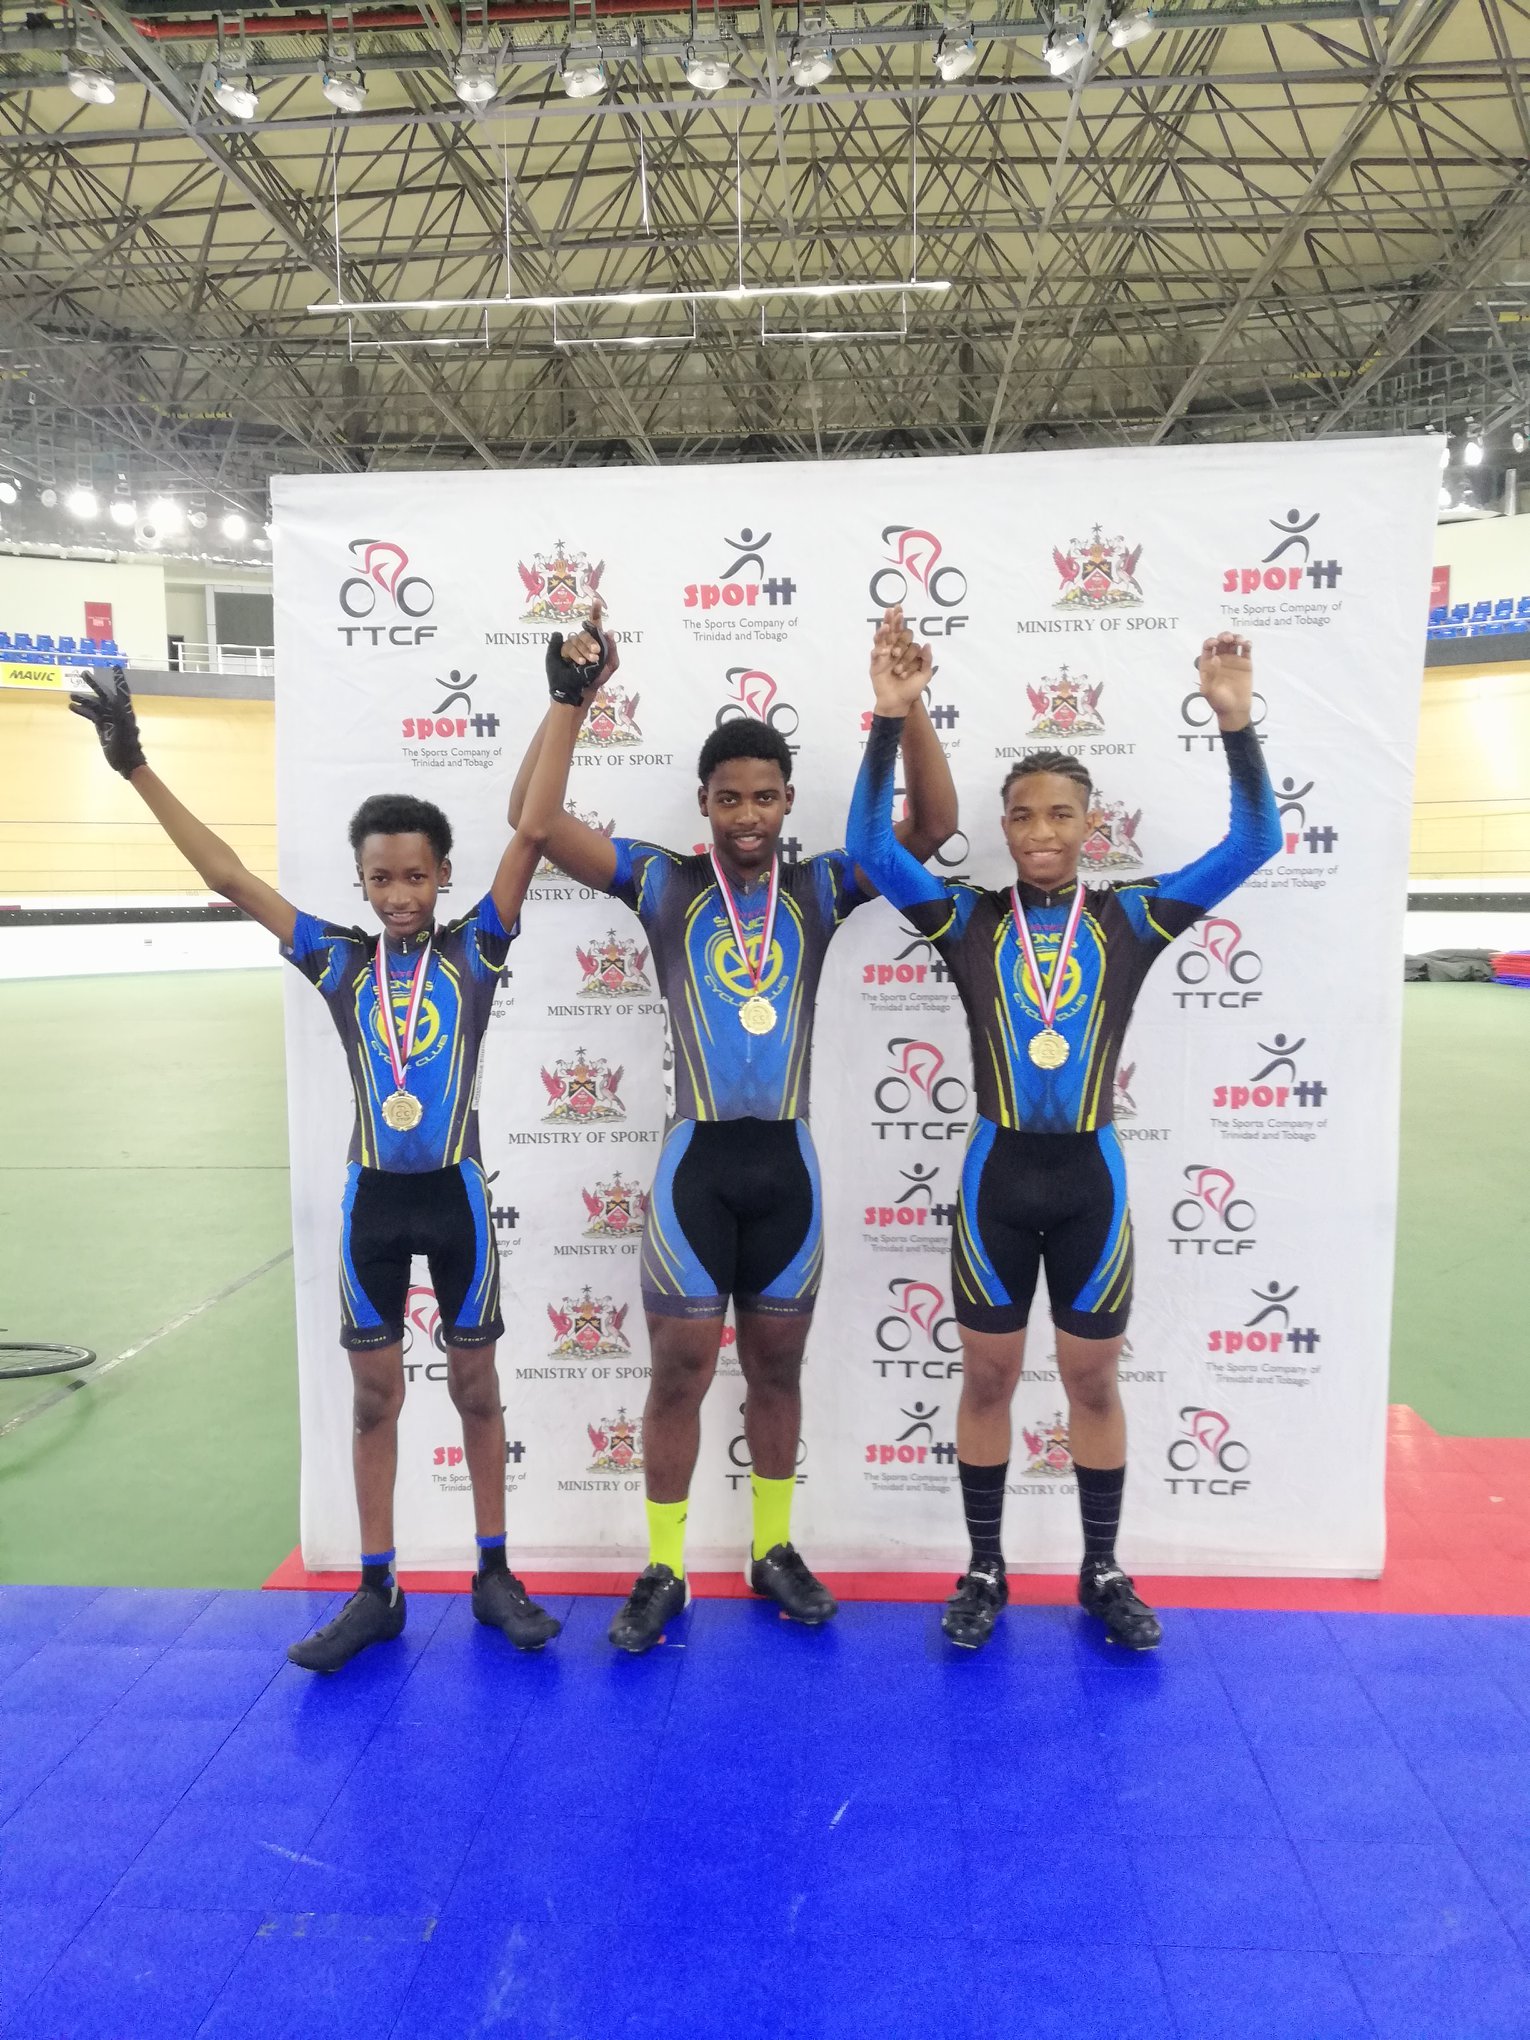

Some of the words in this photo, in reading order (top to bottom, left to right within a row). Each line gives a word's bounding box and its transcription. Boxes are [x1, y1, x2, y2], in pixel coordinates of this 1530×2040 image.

[1220, 605, 1240, 614] The
[1243, 604, 1278, 617] Sports
[1280, 603, 1328, 615] Company
[1332, 601, 1342, 611] of
[683, 619, 701, 629] The
[705, 619, 735, 630] Sports
[740, 618, 784, 630] Company
[788, 617, 798, 627] of
[1017, 619, 1095, 633] MINISTRY
[1100, 618, 1121, 631] OF
[1127, 617, 1179, 630] SPORT
[1230, 616, 1271, 626] Trinidad
[1274, 616, 1293, 625] and
[1295, 615, 1331, 627] Tobago
[338, 626, 437, 646] TTCF
[485, 633, 551, 646] MINISTR
[614, 631, 644, 644] ORT
[693, 631, 731, 641] Trinidad
[735, 631, 752, 640] and
[754, 631, 787, 642] Tobago
[9, 670, 55, 681] MAVIC
[402, 748, 420, 756] The
[421, 748, 448, 758] Sports
[450, 748, 491, 759] Company
[493, 747, 502, 756] of
[1068, 745, 1085, 757] OF
[1090, 744, 1136, 755] SPORT
[412, 758, 445, 767] Trinidad
[448, 759, 462, 767] and
[463, 759, 493, 769] Tobago
[607, 755, 624, 765] OF
[630, 755, 673, 765] SPORT
[1277, 866, 1324, 878] Company
[1328, 865, 1338, 874] of
[1271, 879, 1288, 887] and
[1291, 878, 1326, 889] Tobago
[579, 888, 602, 900] OF
[862, 993, 877, 1001] The
[880, 993, 906, 1002] Sports
[909, 993, 948, 1003] Company
[1173, 992, 1262, 1008] TTCF
[548, 1005, 611, 1016] MINISTRY
[616, 1005, 633, 1015] OF
[870, 1003, 902, 1011] Trinidad
[905, 1003, 920, 1011] and
[921, 1003, 950, 1013] Tobago
[416, 1034, 449, 1067] CLUB
[872, 1122, 969, 1140] TTCF
[1210, 1118, 1229, 1127] The
[1232, 1119, 1264, 1130] Sports
[1267, 1119, 1314, 1131] Company
[1317, 1119, 1328, 1128] of
[509, 1132, 581, 1144] MINISTRY
[586, 1132, 606, 1143] OF
[611, 1131, 659, 1142] SPORT
[1120, 1128, 1171, 1141] SPORT
[1220, 1130, 1259, 1139] Trinidad
[1262, 1131, 1280, 1139] and
[1282, 1130, 1316, 1142] Tobago
[862, 1234, 878, 1243] The
[910, 1235, 948, 1244] Company
[554, 1245, 617, 1255] MINISTRY
[621, 1245, 638, 1254] OF
[1168, 1239, 1256, 1255] TTCF
[403, 1363, 448, 1382] TC
[516, 1368, 587, 1379] MINISTRY
[592, 1368, 611, 1379] OF
[615, 1366, 652, 1379] SPOR
[873, 1360, 964, 1379] TTCF
[1205, 1362, 1224, 1371] The
[1227, 1363, 1258, 1373] Sports
[1261, 1363, 1306, 1374] Company
[1310, 1365, 1321, 1374] of
[1117, 1370, 1167, 1383] SPORT
[432, 1475, 447, 1483] The
[864, 1472, 879, 1480] The
[910, 1473, 948, 1484] Company
[558, 1481, 620, 1491] MINISTRY
[624, 1481, 641, 1491] OF
[1164, 1479, 1251, 1495] TTCF
